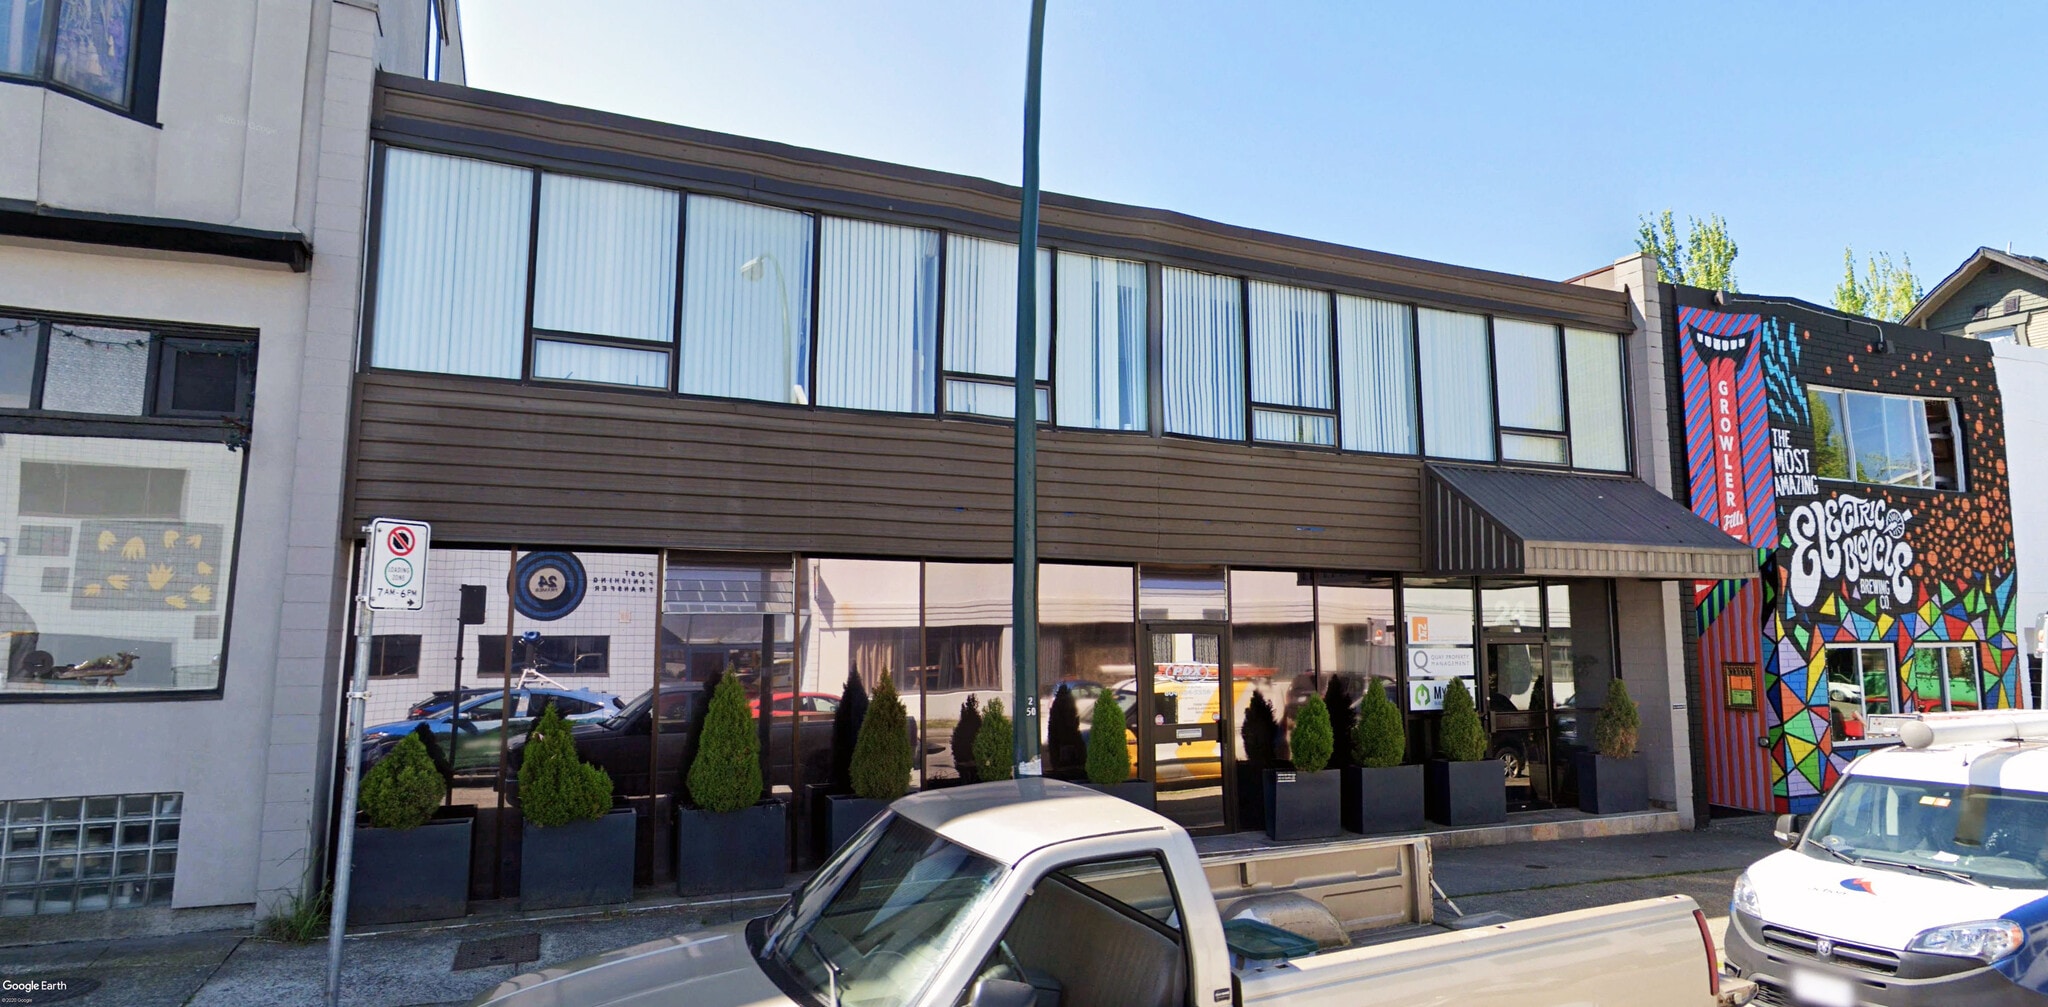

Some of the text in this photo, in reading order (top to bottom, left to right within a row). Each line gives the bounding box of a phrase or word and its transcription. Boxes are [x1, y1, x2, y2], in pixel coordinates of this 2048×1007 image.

[1718, 380, 1735, 507] GROWLER
[1771, 428, 1792, 448] THE
[1772, 448, 1809, 474] MOST
[1774, 474, 1819, 497] AMAZING
[1789, 493, 1886, 607] ELECTRIC
[1842, 528, 1913, 605] BICYCLE
[1860, 578, 1890, 595] BREWING
[1495, 600, 1528, 626] 24
[1026, 707, 1036, 716] 50
[1027, 697, 1033, 706] 2
